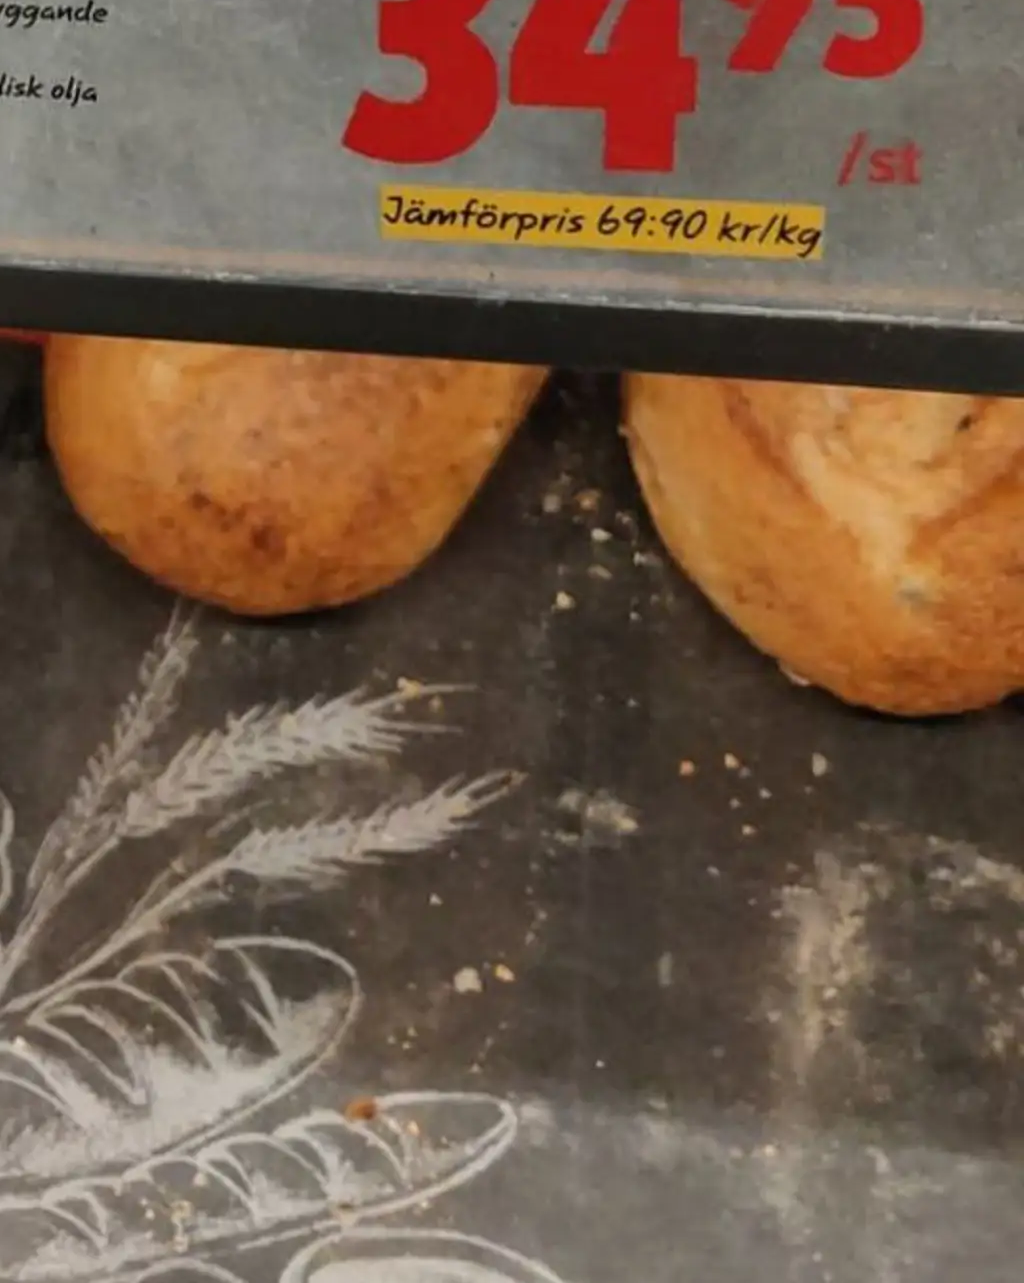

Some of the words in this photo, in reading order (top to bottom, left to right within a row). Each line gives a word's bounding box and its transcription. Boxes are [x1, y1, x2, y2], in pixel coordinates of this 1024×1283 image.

[50, 76, 98, 107] olja
[838, 131, 924, 187] /st
[383, 194, 586, 241] Jämförpris
[597, 204, 707, 241] 69:90
[717, 211, 823, 259] kr/kg
